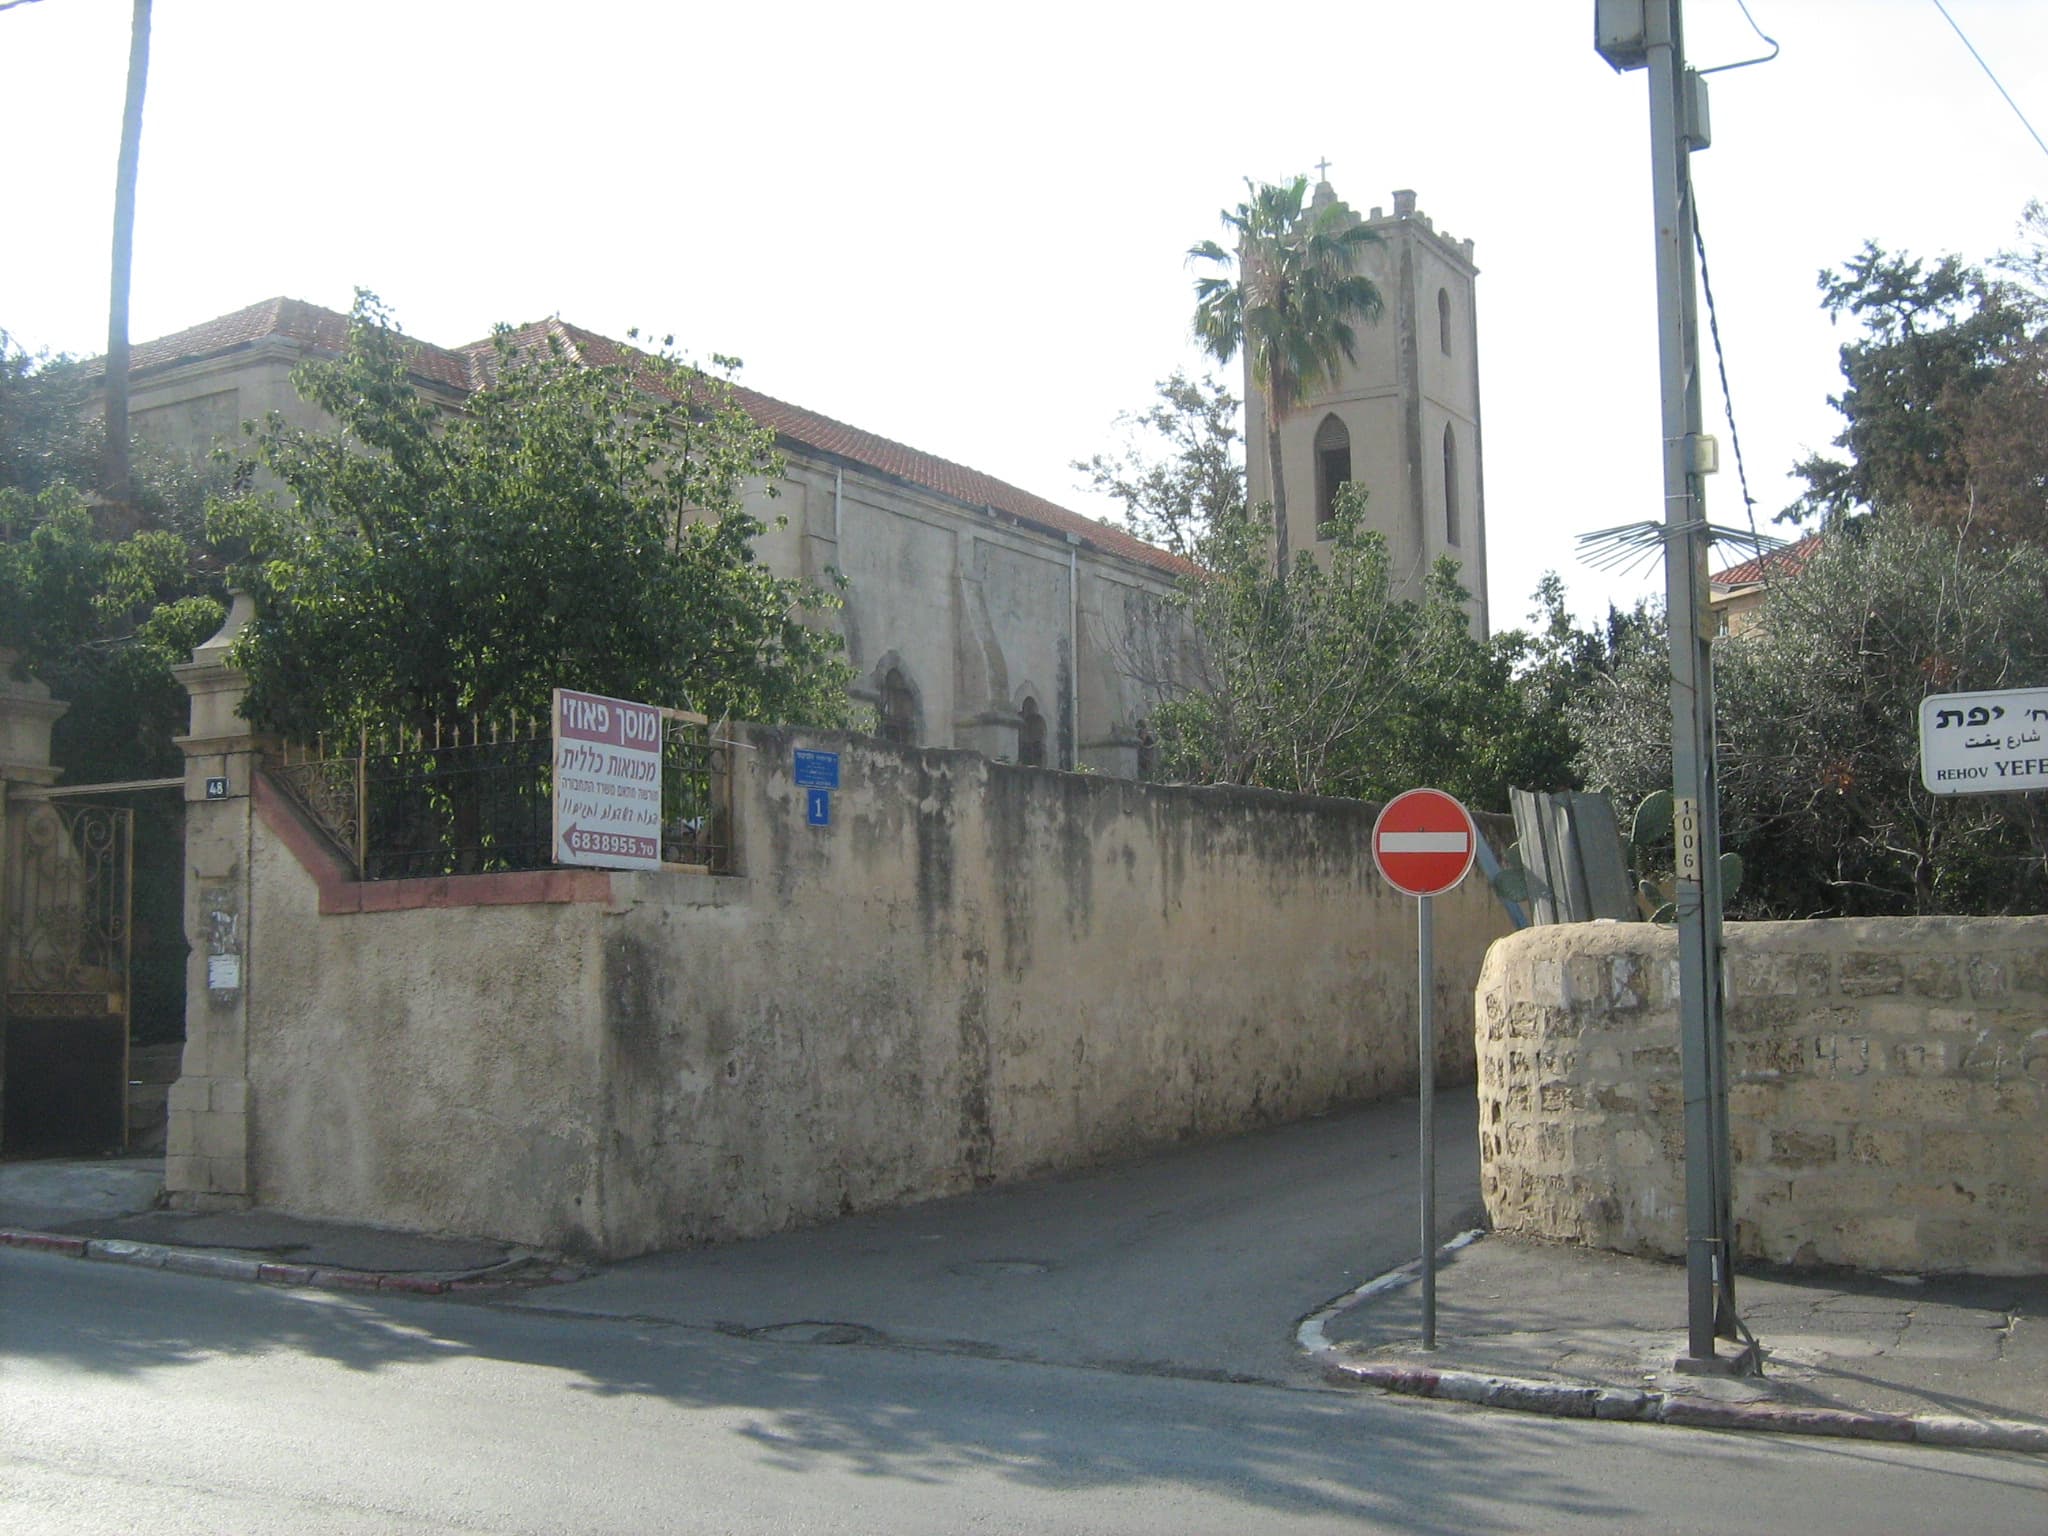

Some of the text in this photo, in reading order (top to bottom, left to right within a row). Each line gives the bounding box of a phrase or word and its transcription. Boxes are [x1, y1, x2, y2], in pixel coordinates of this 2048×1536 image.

[563, 698, 657, 745] מוסך פאוזי
[1936, 705, 2005, 729] יפת
[2006, 729, 2041, 750] شارع
[561, 745, 656, 782] מכונאות כללית
[1937, 758, 2048, 781] REHOV YEFE
[209, 781, 224, 795] 48
[562, 777, 595, 793] התחבורה
[597, 782, 616, 796] משרד
[815, 797, 823, 817] 1
[571, 831, 637, 854] 6838955
